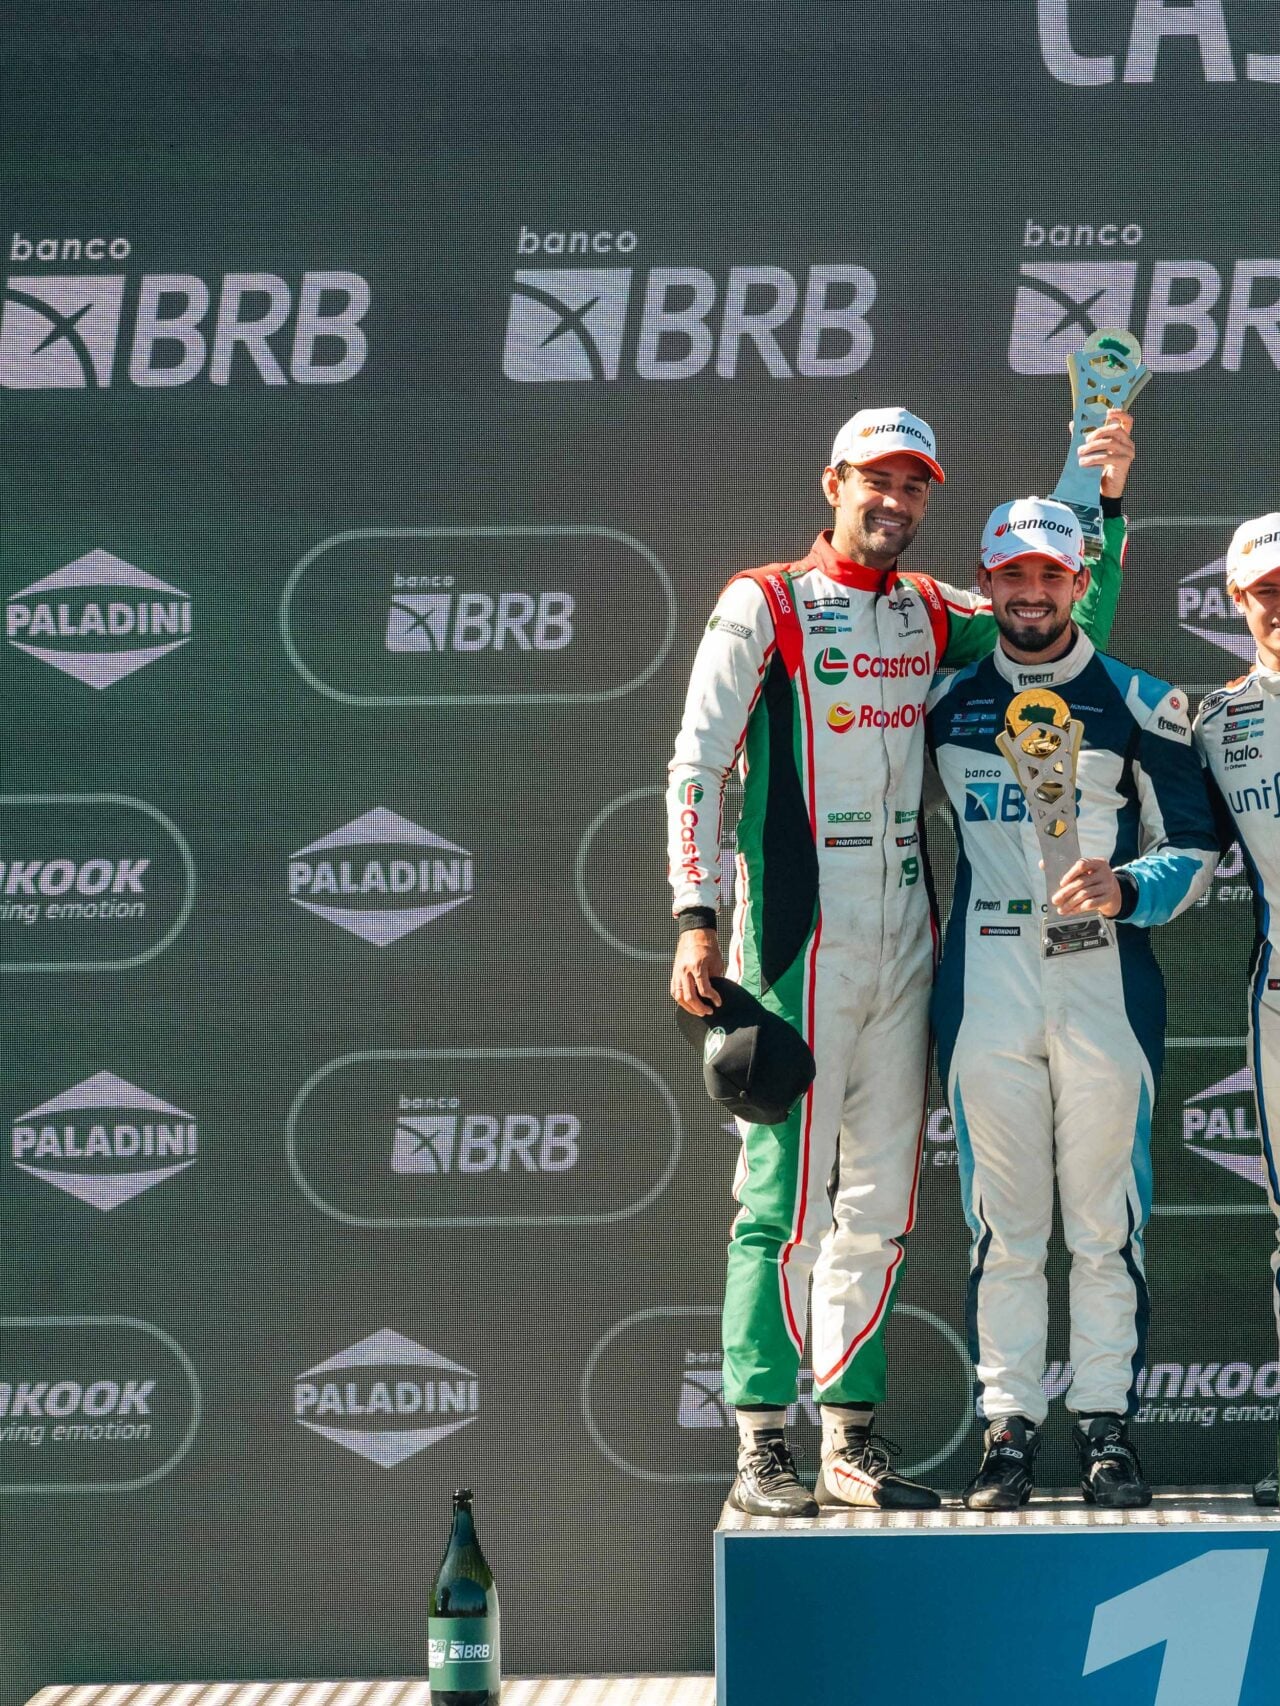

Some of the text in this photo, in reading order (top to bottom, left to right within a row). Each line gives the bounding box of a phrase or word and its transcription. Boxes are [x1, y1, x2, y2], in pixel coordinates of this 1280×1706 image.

[10, 233, 132, 261] banco
[518, 226, 638, 254] banco
[1023, 219, 1144, 247] banco
[128, 270, 372, 388] BRB
[635, 263, 877, 381] BRB
[393, 573, 454, 587] banco
[6, 599, 192, 639] PALADINI
[451, 592, 576, 651] BRB
[853, 652, 930, 680] Castrol
[858, 703, 926, 729] RodOil
[964, 768, 1002, 779] banco
[827, 811, 872, 823] sparco
[0, 858, 151, 896] KOOK
[288, 858, 474, 895] PALADINI
[46, 898, 145, 918] emotion
[399, 1094, 460, 1109] banco
[12, 1124, 197, 1159] PALADINI
[457, 1113, 581, 1173] BRB
[294, 1381, 479, 1415] PALADINI
[51, 1420, 152, 1441] emotion
[1083, 1548, 1270, 1706] 1
[463, 1644, 490, 1659] BRB
